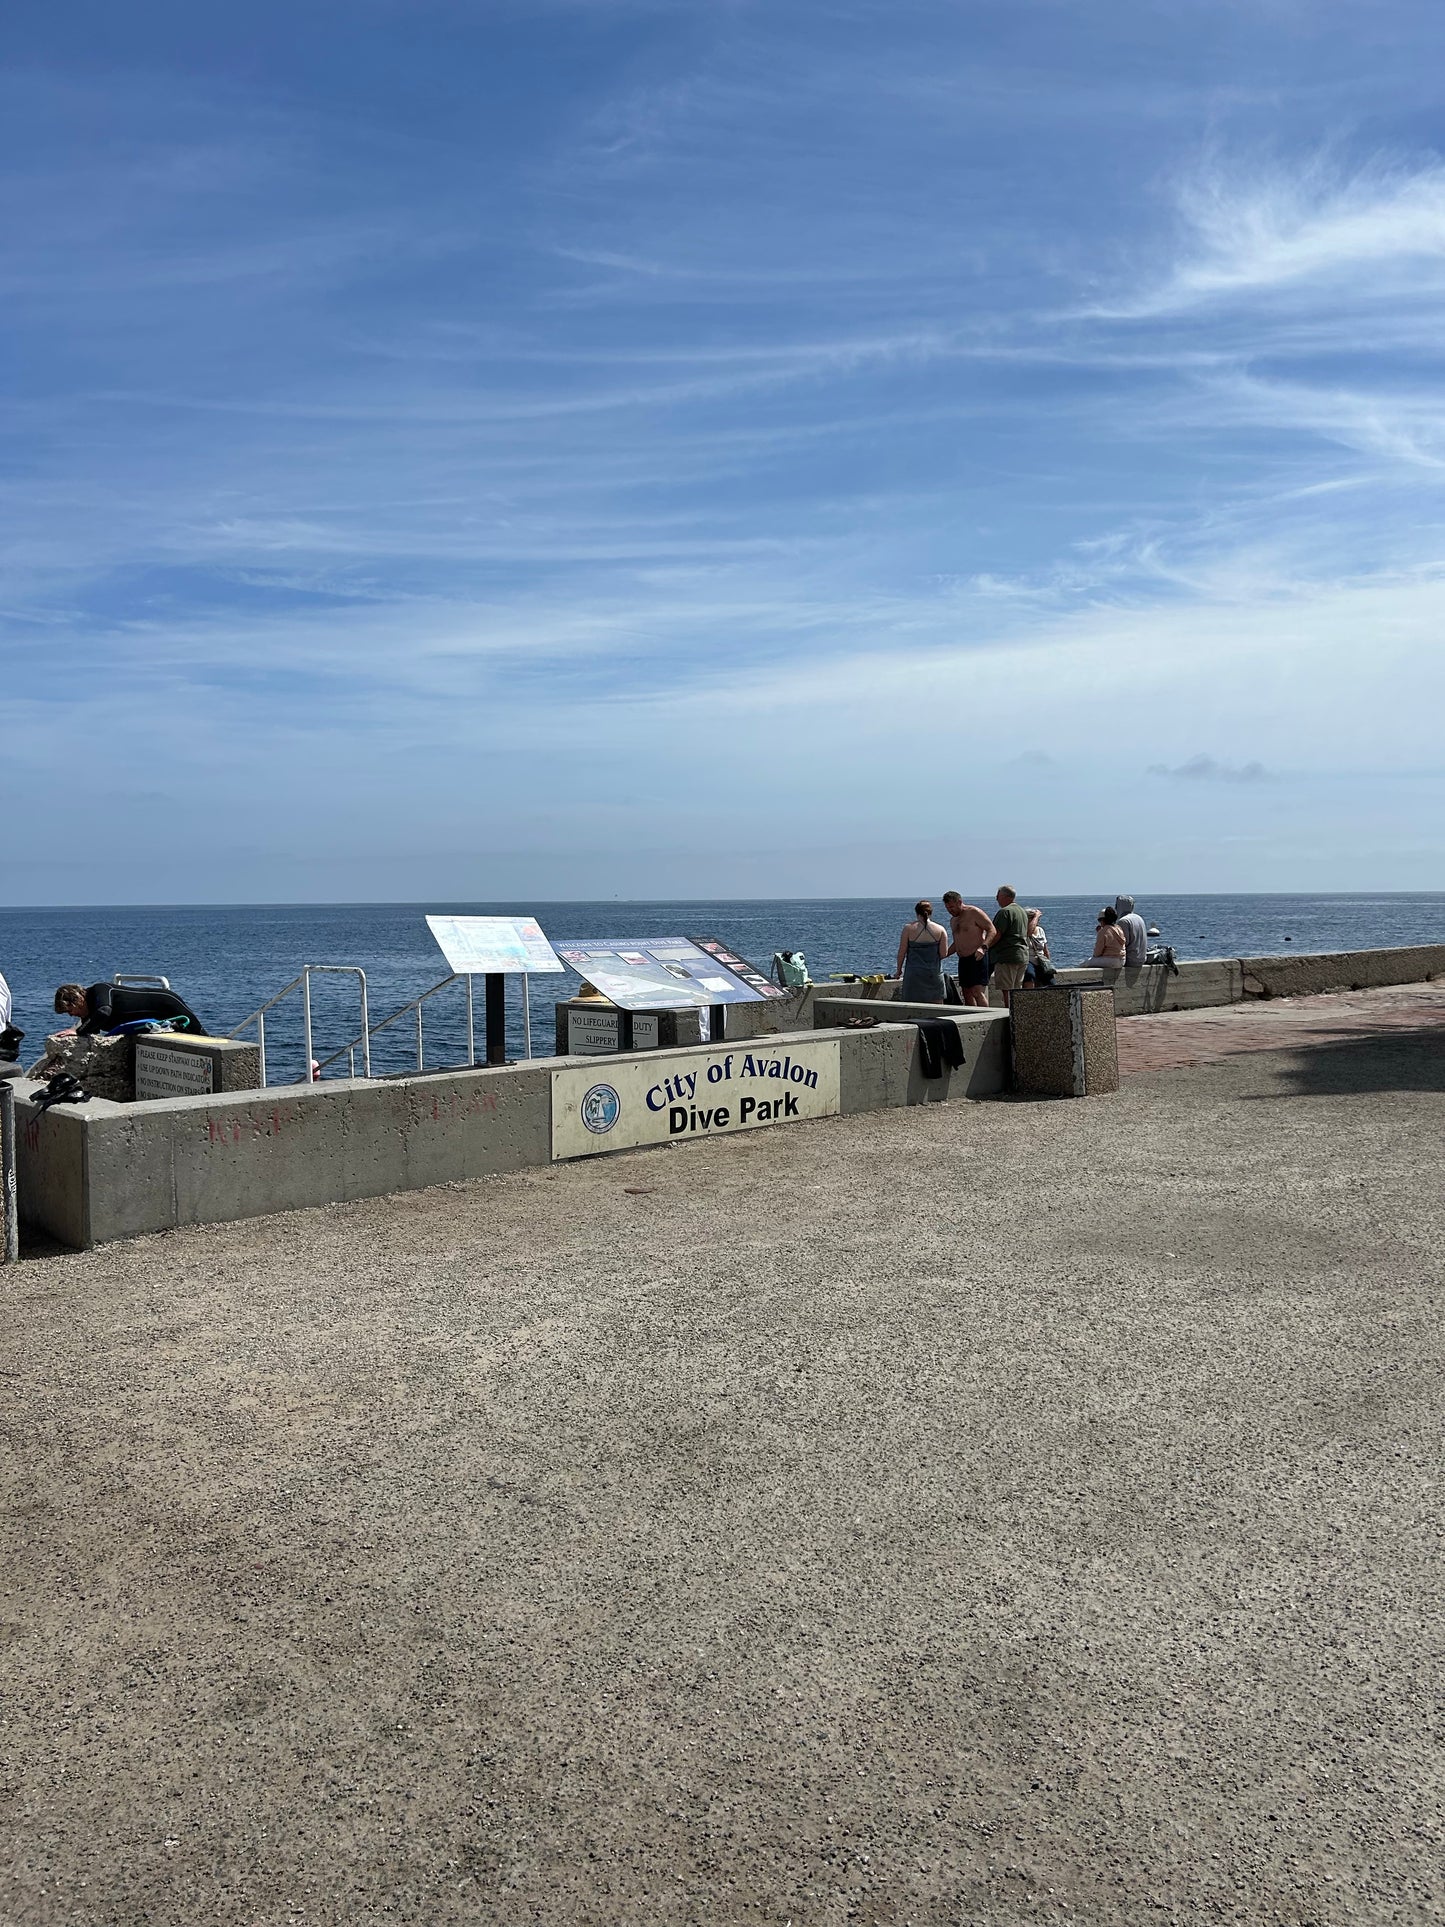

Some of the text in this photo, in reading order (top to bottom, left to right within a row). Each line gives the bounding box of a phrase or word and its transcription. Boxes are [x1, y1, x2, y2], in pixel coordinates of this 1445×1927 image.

[572, 1016, 582, 1025] NO
[634, 1021, 653, 1032] DUTY
[585, 1035, 617, 1046] SLIPPERY
[140, 1049, 156, 1060] PLEASE
[156, 1052, 168, 1062] KEEP
[168, 1054, 190, 1066] STAIRWAY
[140, 1063, 148, 1073] USE
[170, 1069, 182, 1079] PATH
[182, 1071, 210, 1085] INDICATORS
[645, 1070, 698, 1112] City
[706, 1054, 734, 1084] of
[739, 1054, 818, 1090] Avalon
[140, 1077, 200, 1096] NO INSTRUCTION ON STAIRS
[669, 1091, 800, 1135] Dive Park
